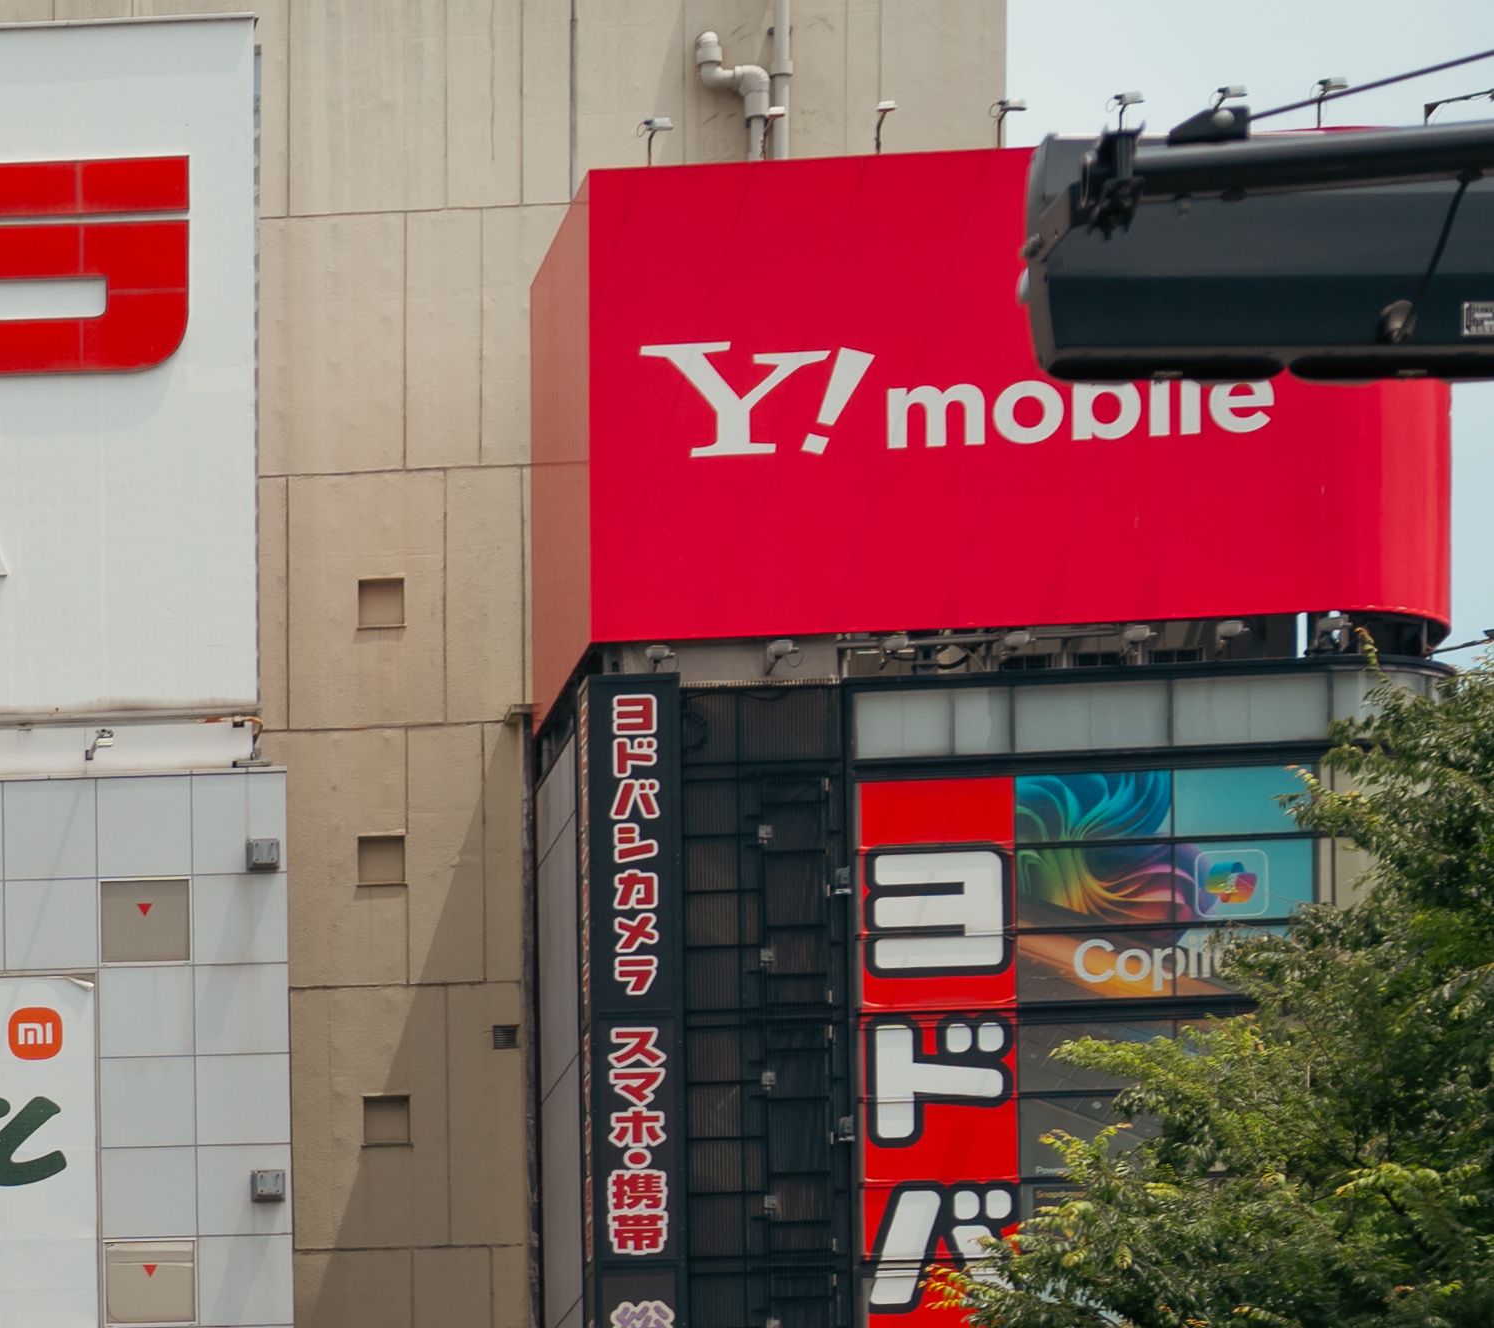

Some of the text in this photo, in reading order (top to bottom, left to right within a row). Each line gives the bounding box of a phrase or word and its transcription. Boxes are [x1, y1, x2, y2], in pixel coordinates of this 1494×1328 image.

[610, 695, 660, 995] ヨドバシカメラ
[609, 1028, 667, 1255] スマホ・携帯
